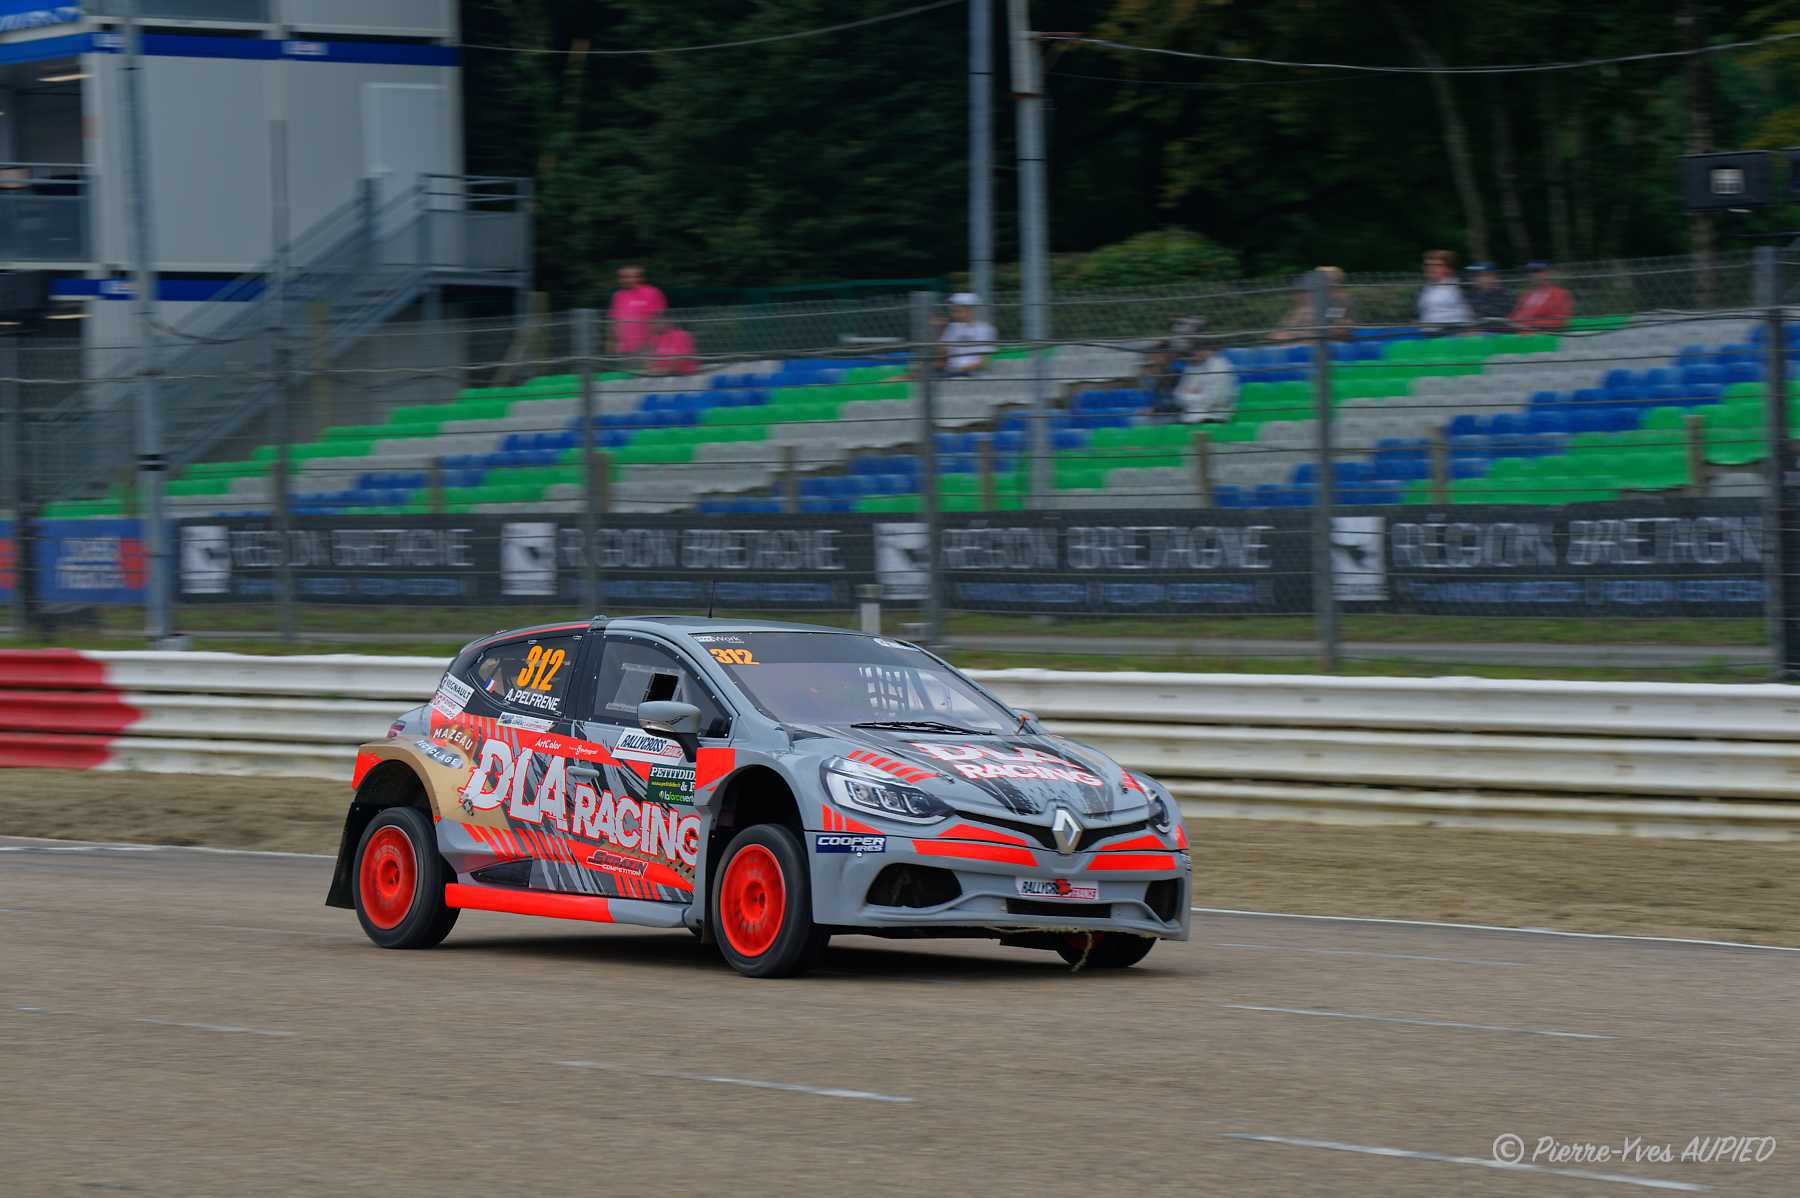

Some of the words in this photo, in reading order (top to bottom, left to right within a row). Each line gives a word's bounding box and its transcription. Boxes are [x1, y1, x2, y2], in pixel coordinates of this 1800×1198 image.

[516, 645, 566, 691] 312
[709, 648, 760, 665] 312
[504, 688, 561, 711] A.PELFRENE
[432, 728, 473, 750] MAZEAU
[620, 734, 667, 753] RALLYCROSS
[911, 743, 1085, 770] DLA
[953, 763, 1105, 787] RACING
[461, 738, 569, 832] DLA
[571, 784, 700, 866] RACING
[817, 836, 886, 846] COOPER
